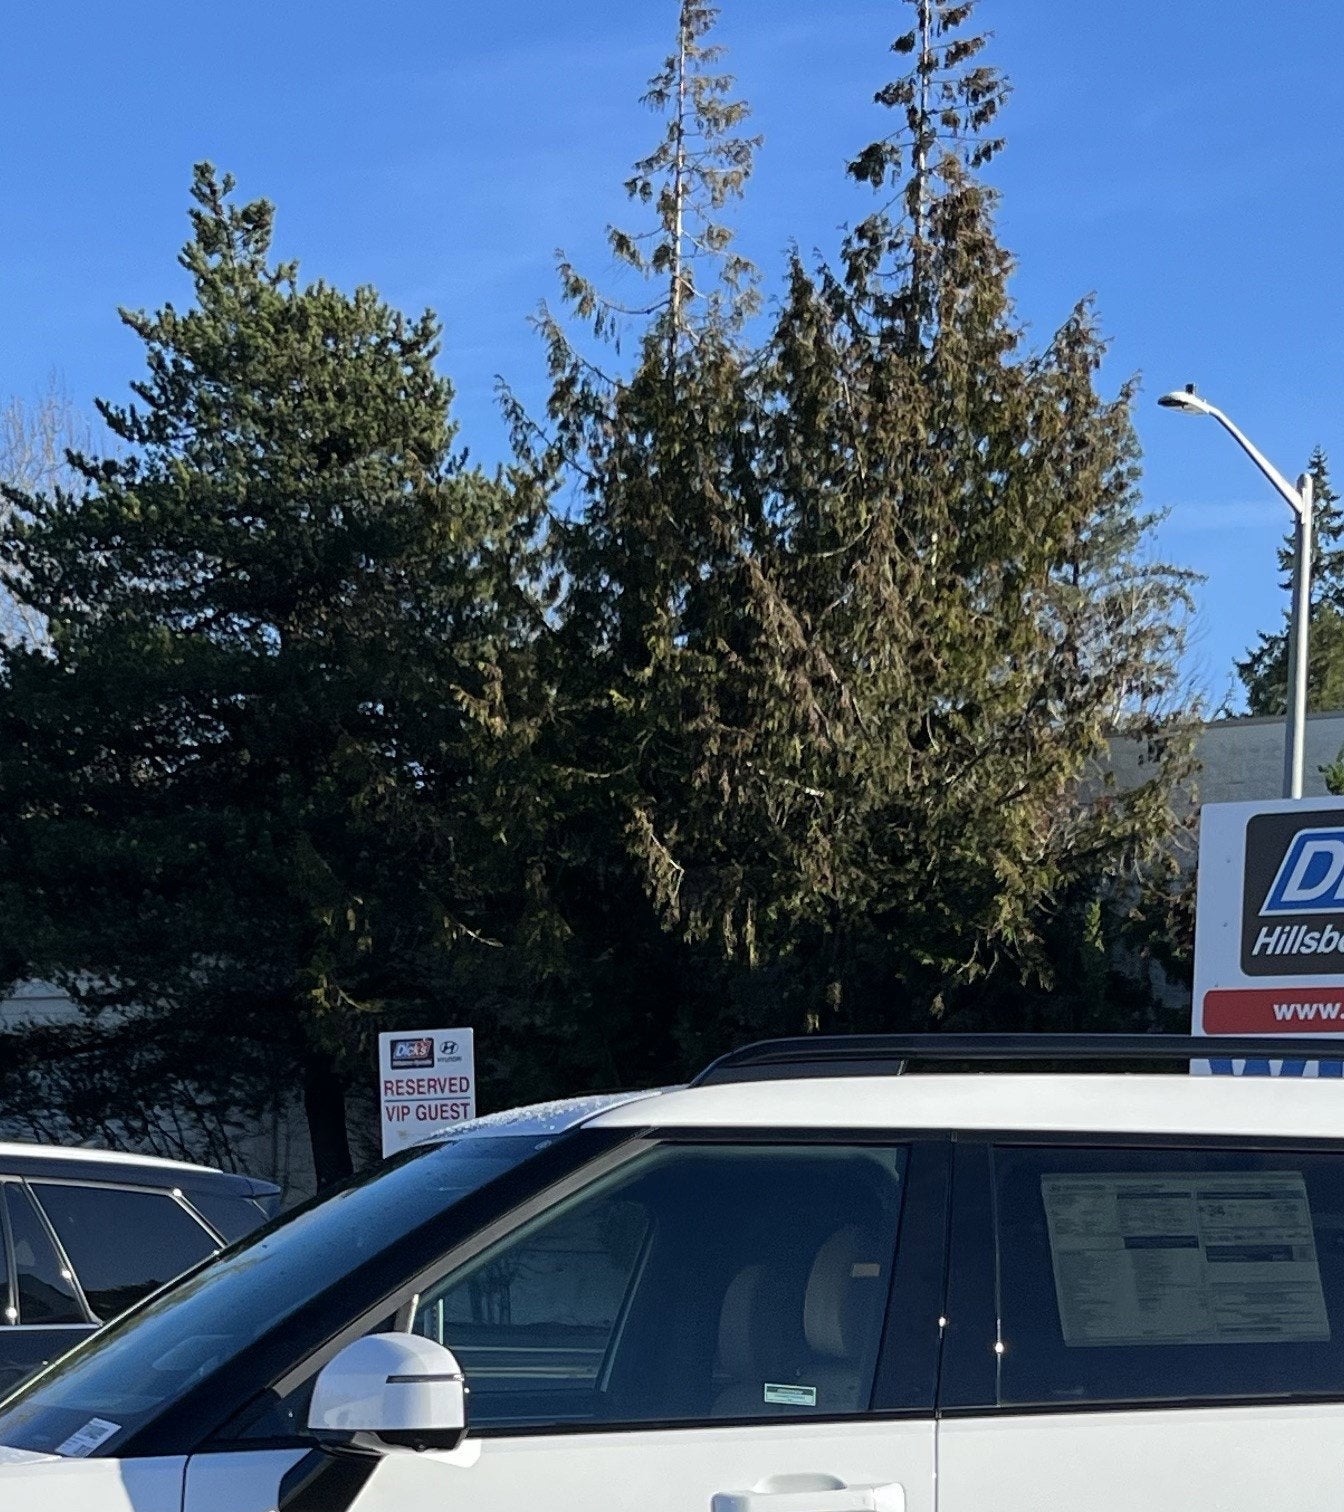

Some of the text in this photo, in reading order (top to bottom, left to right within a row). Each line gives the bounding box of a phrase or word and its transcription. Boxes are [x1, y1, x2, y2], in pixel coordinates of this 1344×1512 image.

[383, 1077, 471, 1096] RESERVED
[385, 1103, 471, 1122] VIP GUEST
